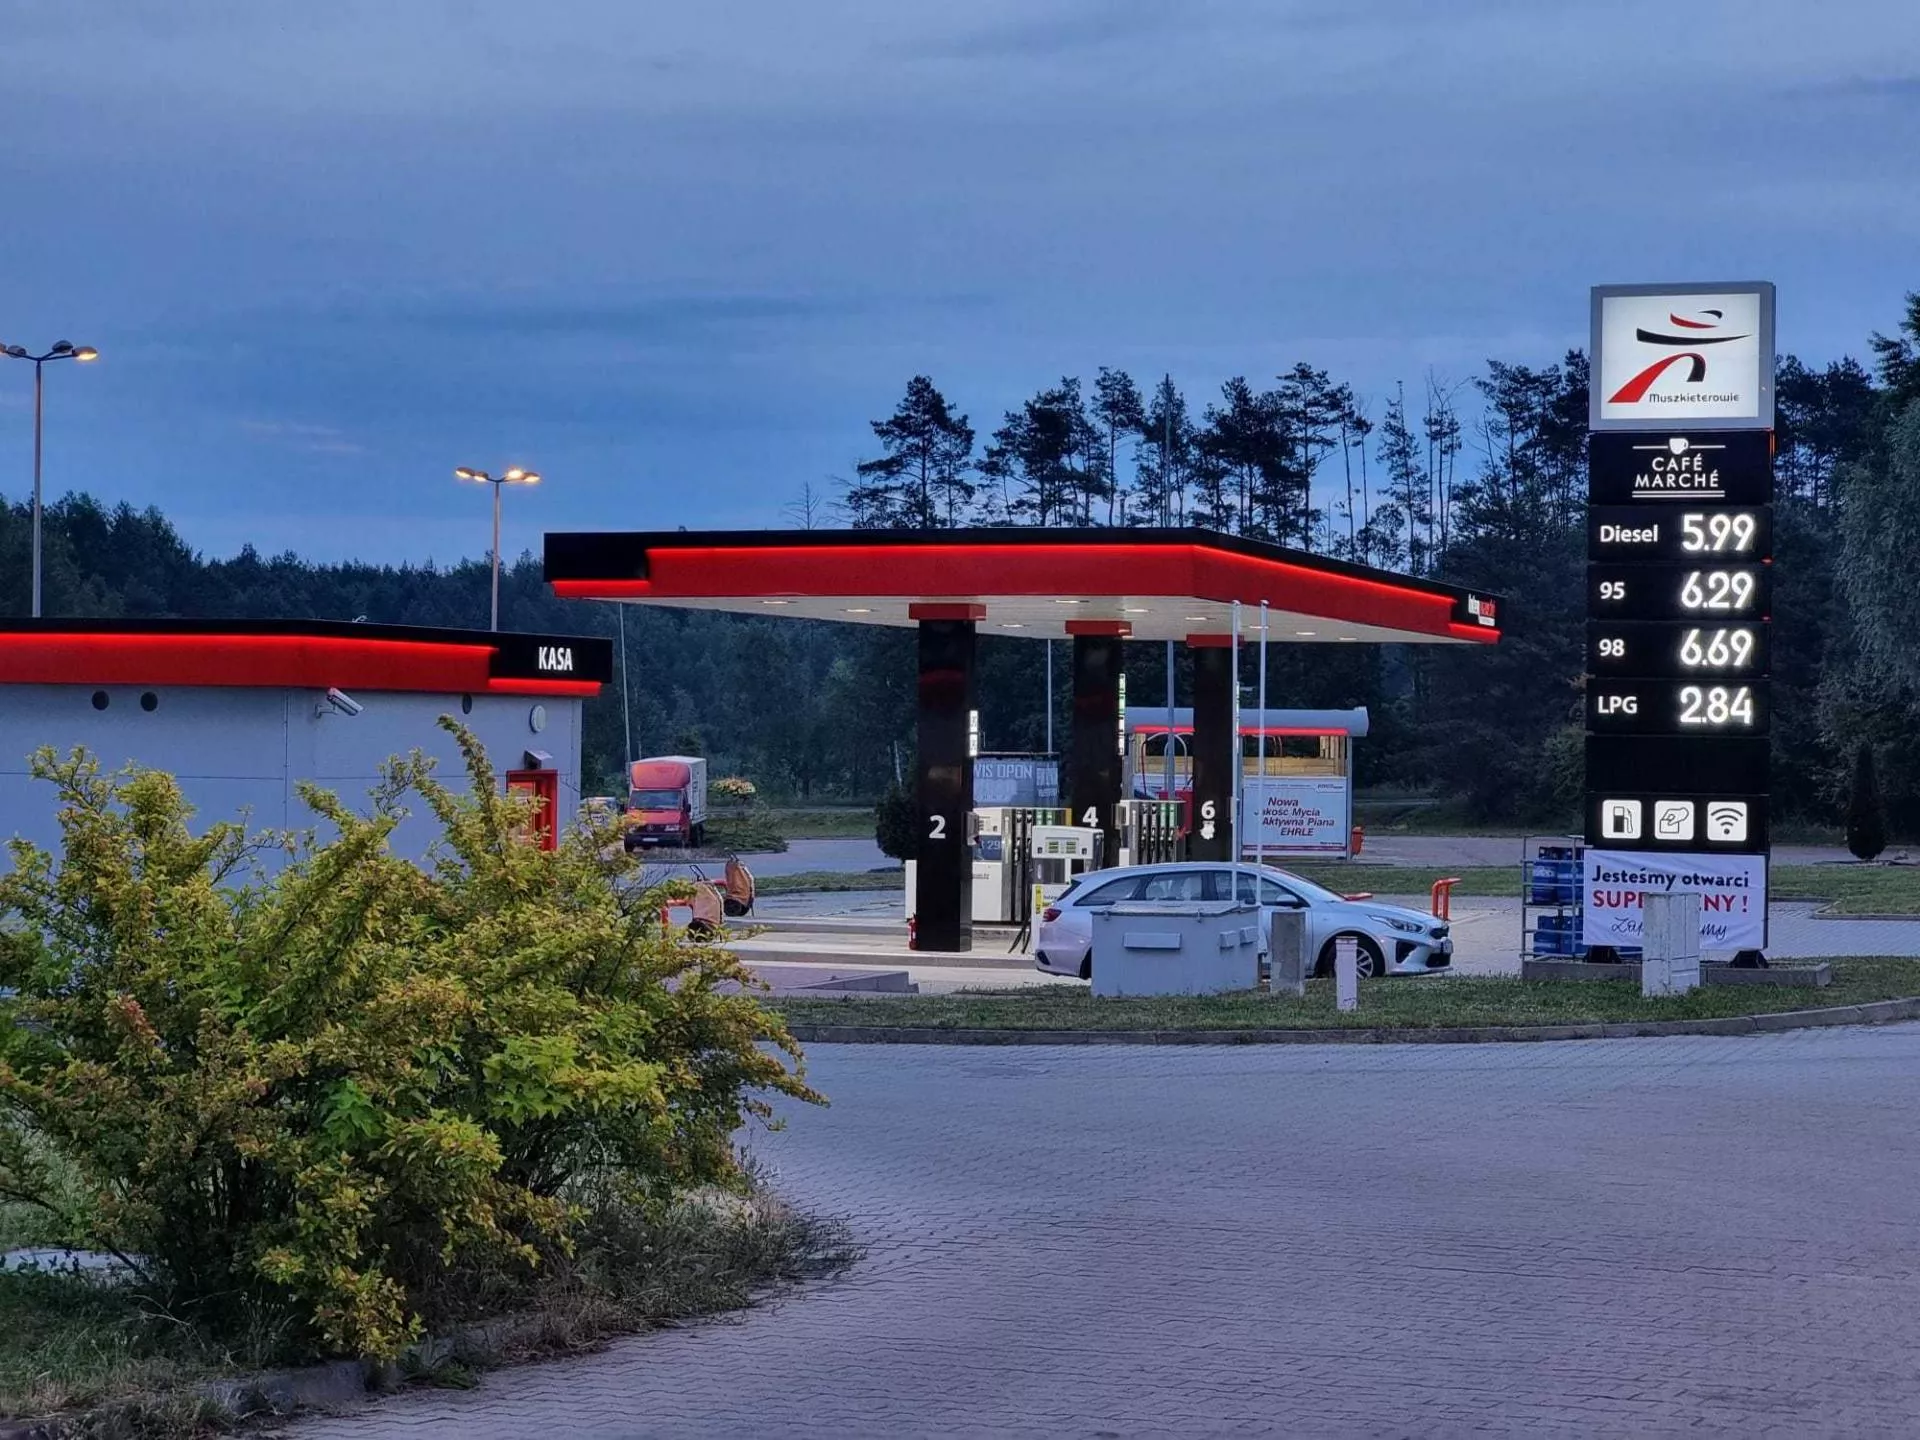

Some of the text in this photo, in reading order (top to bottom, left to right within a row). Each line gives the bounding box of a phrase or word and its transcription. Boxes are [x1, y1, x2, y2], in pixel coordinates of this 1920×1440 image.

[1649, 393, 1739, 403] Muszkieterowie
[1652, 453, 1702, 471] CAFÉ
[1635, 469, 1718, 487] MARCHÉ
[1599, 513, 1756, 552] Diesel 5.99
[1599, 571, 1755, 609] 95 6.29
[1598, 628, 1754, 667] 98 6.69
[538, 646, 573, 671] KASA
[1597, 686, 1754, 725] LPG 2.84
[1201, 800, 1216, 820] 6
[1268, 797, 1299, 806] Nowa
[1082, 806, 1099, 827] 4
[1262, 818, 1335, 827] Aktywna Piana
[1292, 808, 1320, 818] Mycia
[928, 814, 946, 839] 2
[1280, 828, 1314, 836] EHRLE
[1592, 865, 1749, 891] Jesteśmy otwarci
